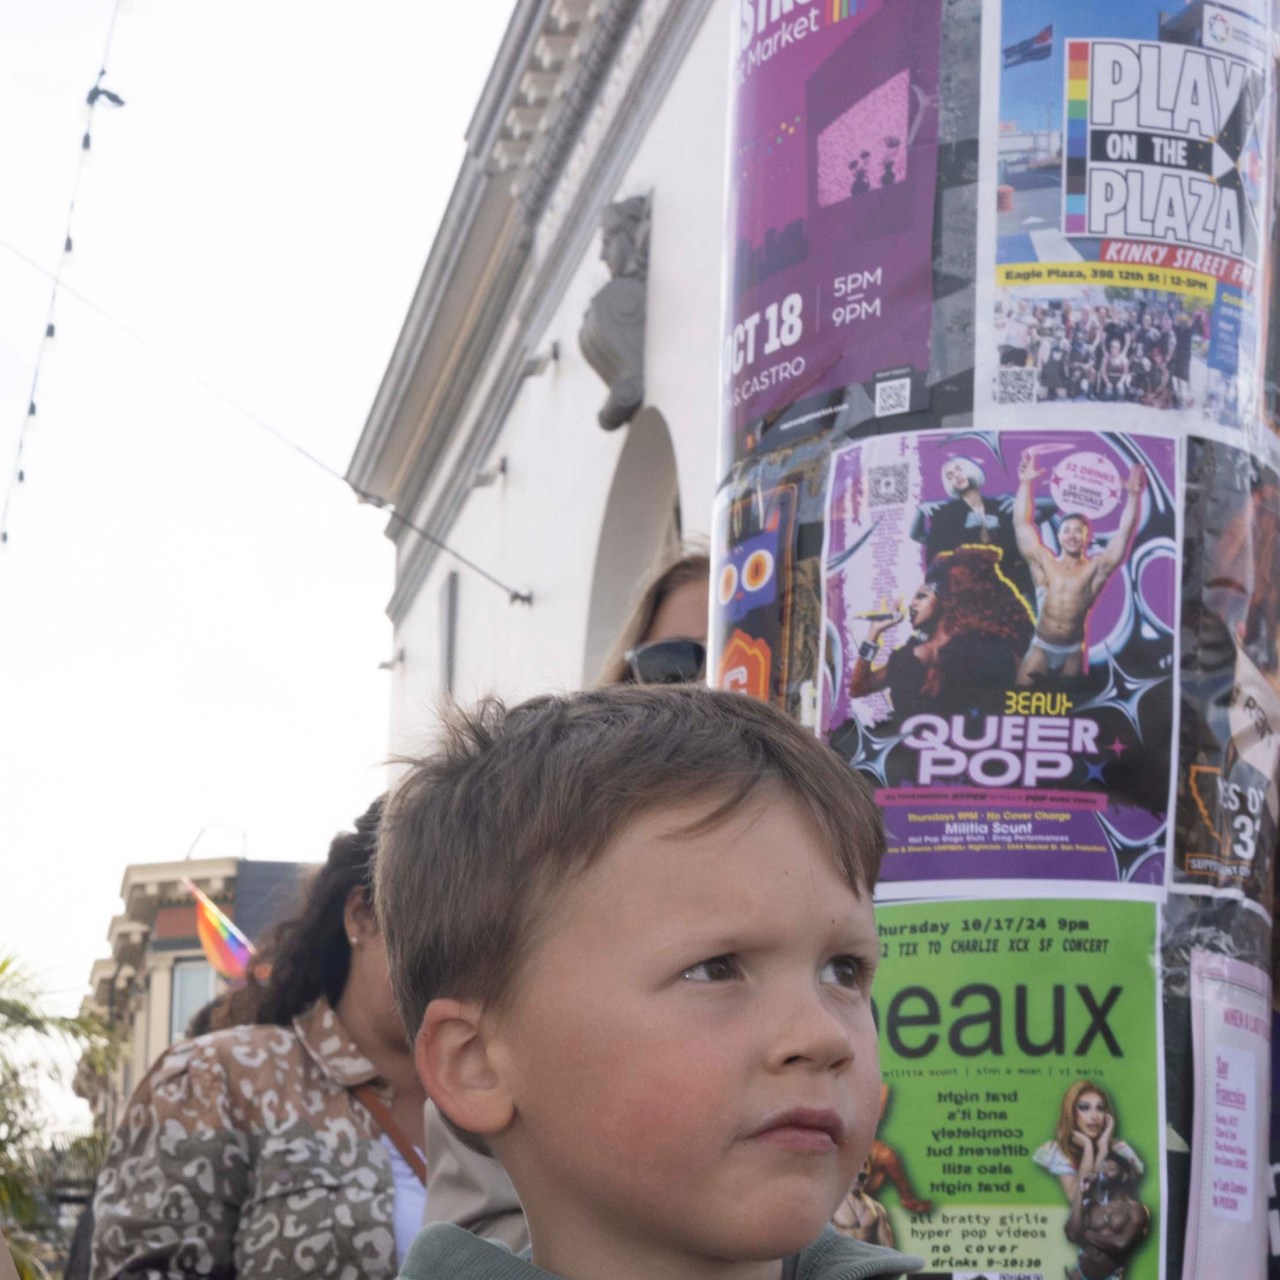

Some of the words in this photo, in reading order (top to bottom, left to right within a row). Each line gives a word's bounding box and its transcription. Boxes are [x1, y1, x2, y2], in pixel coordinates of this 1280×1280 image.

[747, 7, 820, 75] Market
[1090, 41, 1246, 139] PLAY
[1105, 133, 1138, 160] ON
[1151, 136, 1188, 167] THE
[1088, 167, 1244, 256] PLAZA
[1105, 241, 1168, 265] KINKY
[1173, 246, 1229, 278] STREET
[833, 267, 883, 297] 5PM
[1004, 268, 1043, 281] Eagle
[1047, 268, 1087, 281] Plaza,
[1091, 269, 1114, 280] 398
[1118, 270, 1144, 281] 12th
[1147, 271, 1160, 283] St
[764, 293, 803, 354] 18
[832, 298, 881, 327] 9PM
[741, 357, 806, 400] CASTRO
[900, 714, 1100, 754] QUEER
[918, 749, 1073, 787] POP
[945, 822, 988, 834] Militia
[992, 822, 1032, 834] Scunt
[987, 811, 1001, 820] No
[1003, 811, 1032, 820] Cover
[1034, 811, 1072, 822] Charge
[879, 920, 950, 937] hursday
[961, 916, 1047, 933] 10/17/24
[1057, 918, 1090, 933] 9pm
[899, 942, 918, 957] TIX
[928, 941, 941, 954] TO
[951, 939, 998, 953] CHARLIE
[1009, 939, 1029, 952] XCX
[1040, 938, 1053, 952] SF
[1063, 939, 1109, 953] CONCERT
[870, 982, 1124, 1059] eaux
[910, 1213, 933, 1225] all
[942, 1213, 990, 1226] bratty
[999, 1213, 1048, 1226] girlie
[911, 1228, 952, 1240] hyper
[961, 1229, 987, 1240] pop
[997, 1227, 1046, 1239] videos
[931, 1244, 951, 1253] no
[965, 1244, 1019, 1253] cover
[932, 1258, 978, 1268] drinks
